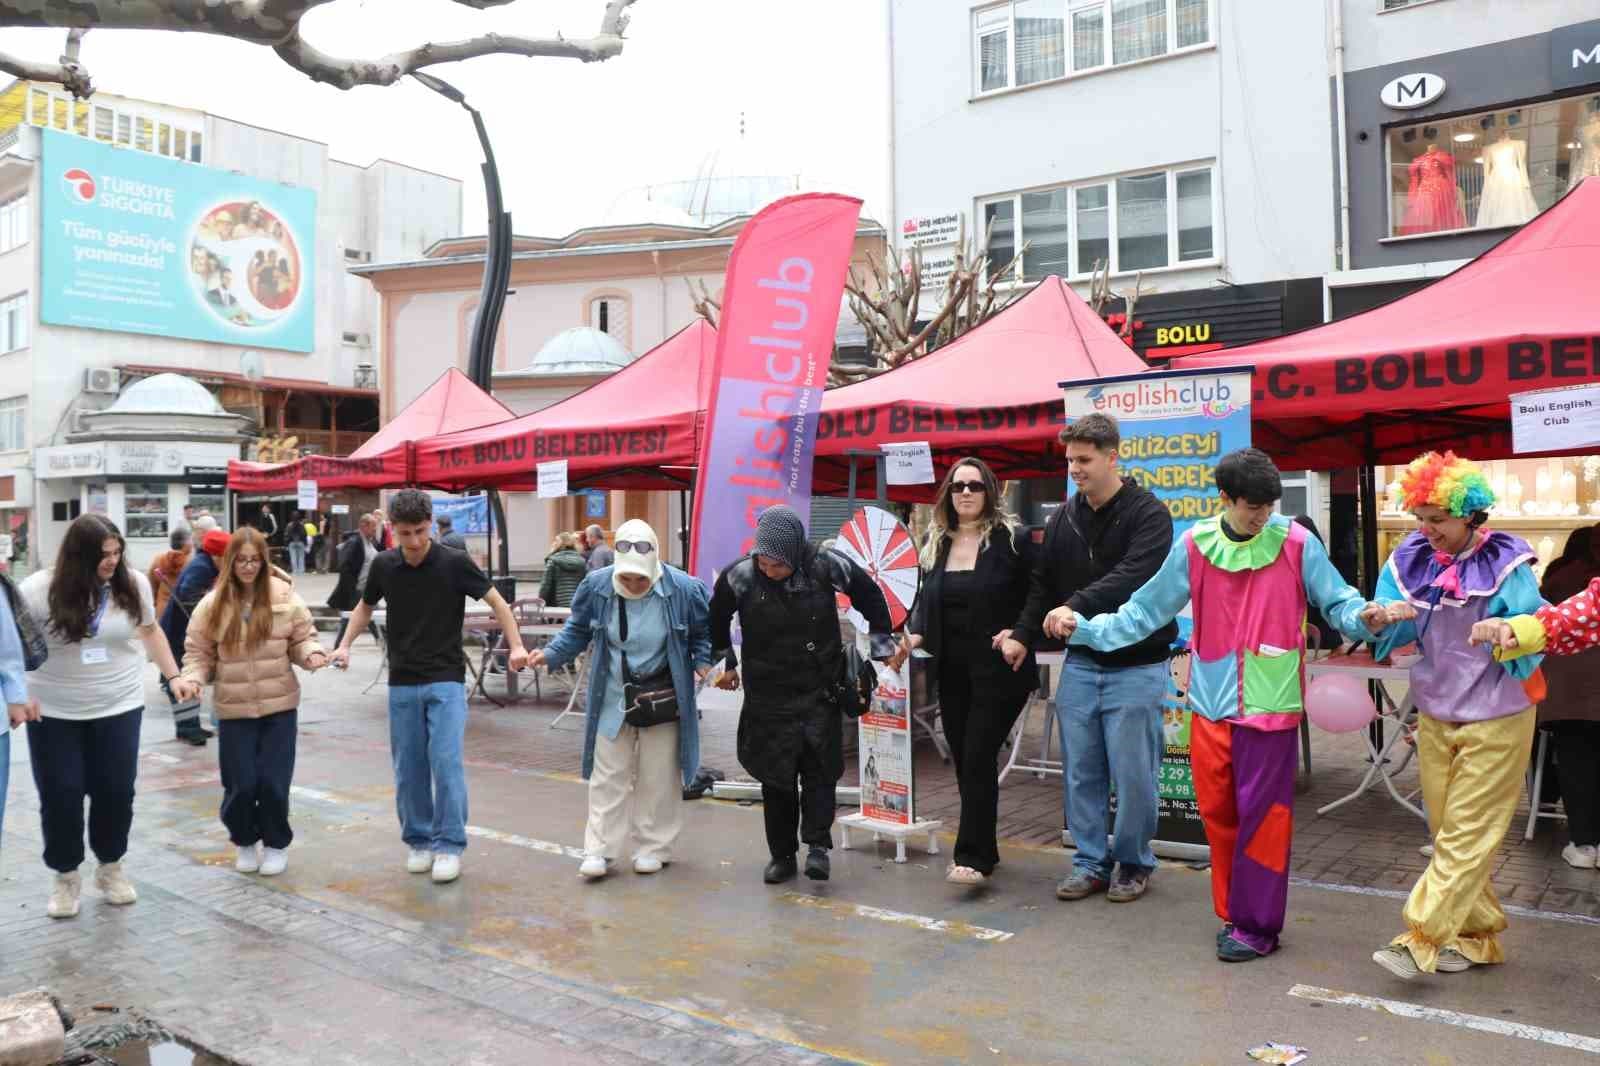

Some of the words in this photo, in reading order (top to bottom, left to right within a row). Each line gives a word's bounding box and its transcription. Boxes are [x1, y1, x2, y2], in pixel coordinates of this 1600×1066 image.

[1397, 77, 1426, 103] M
[1156, 323, 1210, 345] BOLU
[1254, 364, 1315, 401] .C.
[1335, 346, 1484, 395] BOLU
[1094, 378, 1231, 413] englishclub
[1519, 404, 1545, 414] Bolu
[1549, 400, 1592, 411] English
[816, 407, 877, 440] OLU
[1543, 416, 1570, 426] Club
[438, 449, 468, 469] T.C.
[474, 437, 527, 465] BOLU
[533, 424, 669, 458] BELEDİYESİ
[1118, 431, 1218, 459] GİLİZCEYİ
[1158, 766, 1166, 779] 3
[1168, 767, 1185, 781] 29
[1175, 784, 1190, 795] 98
